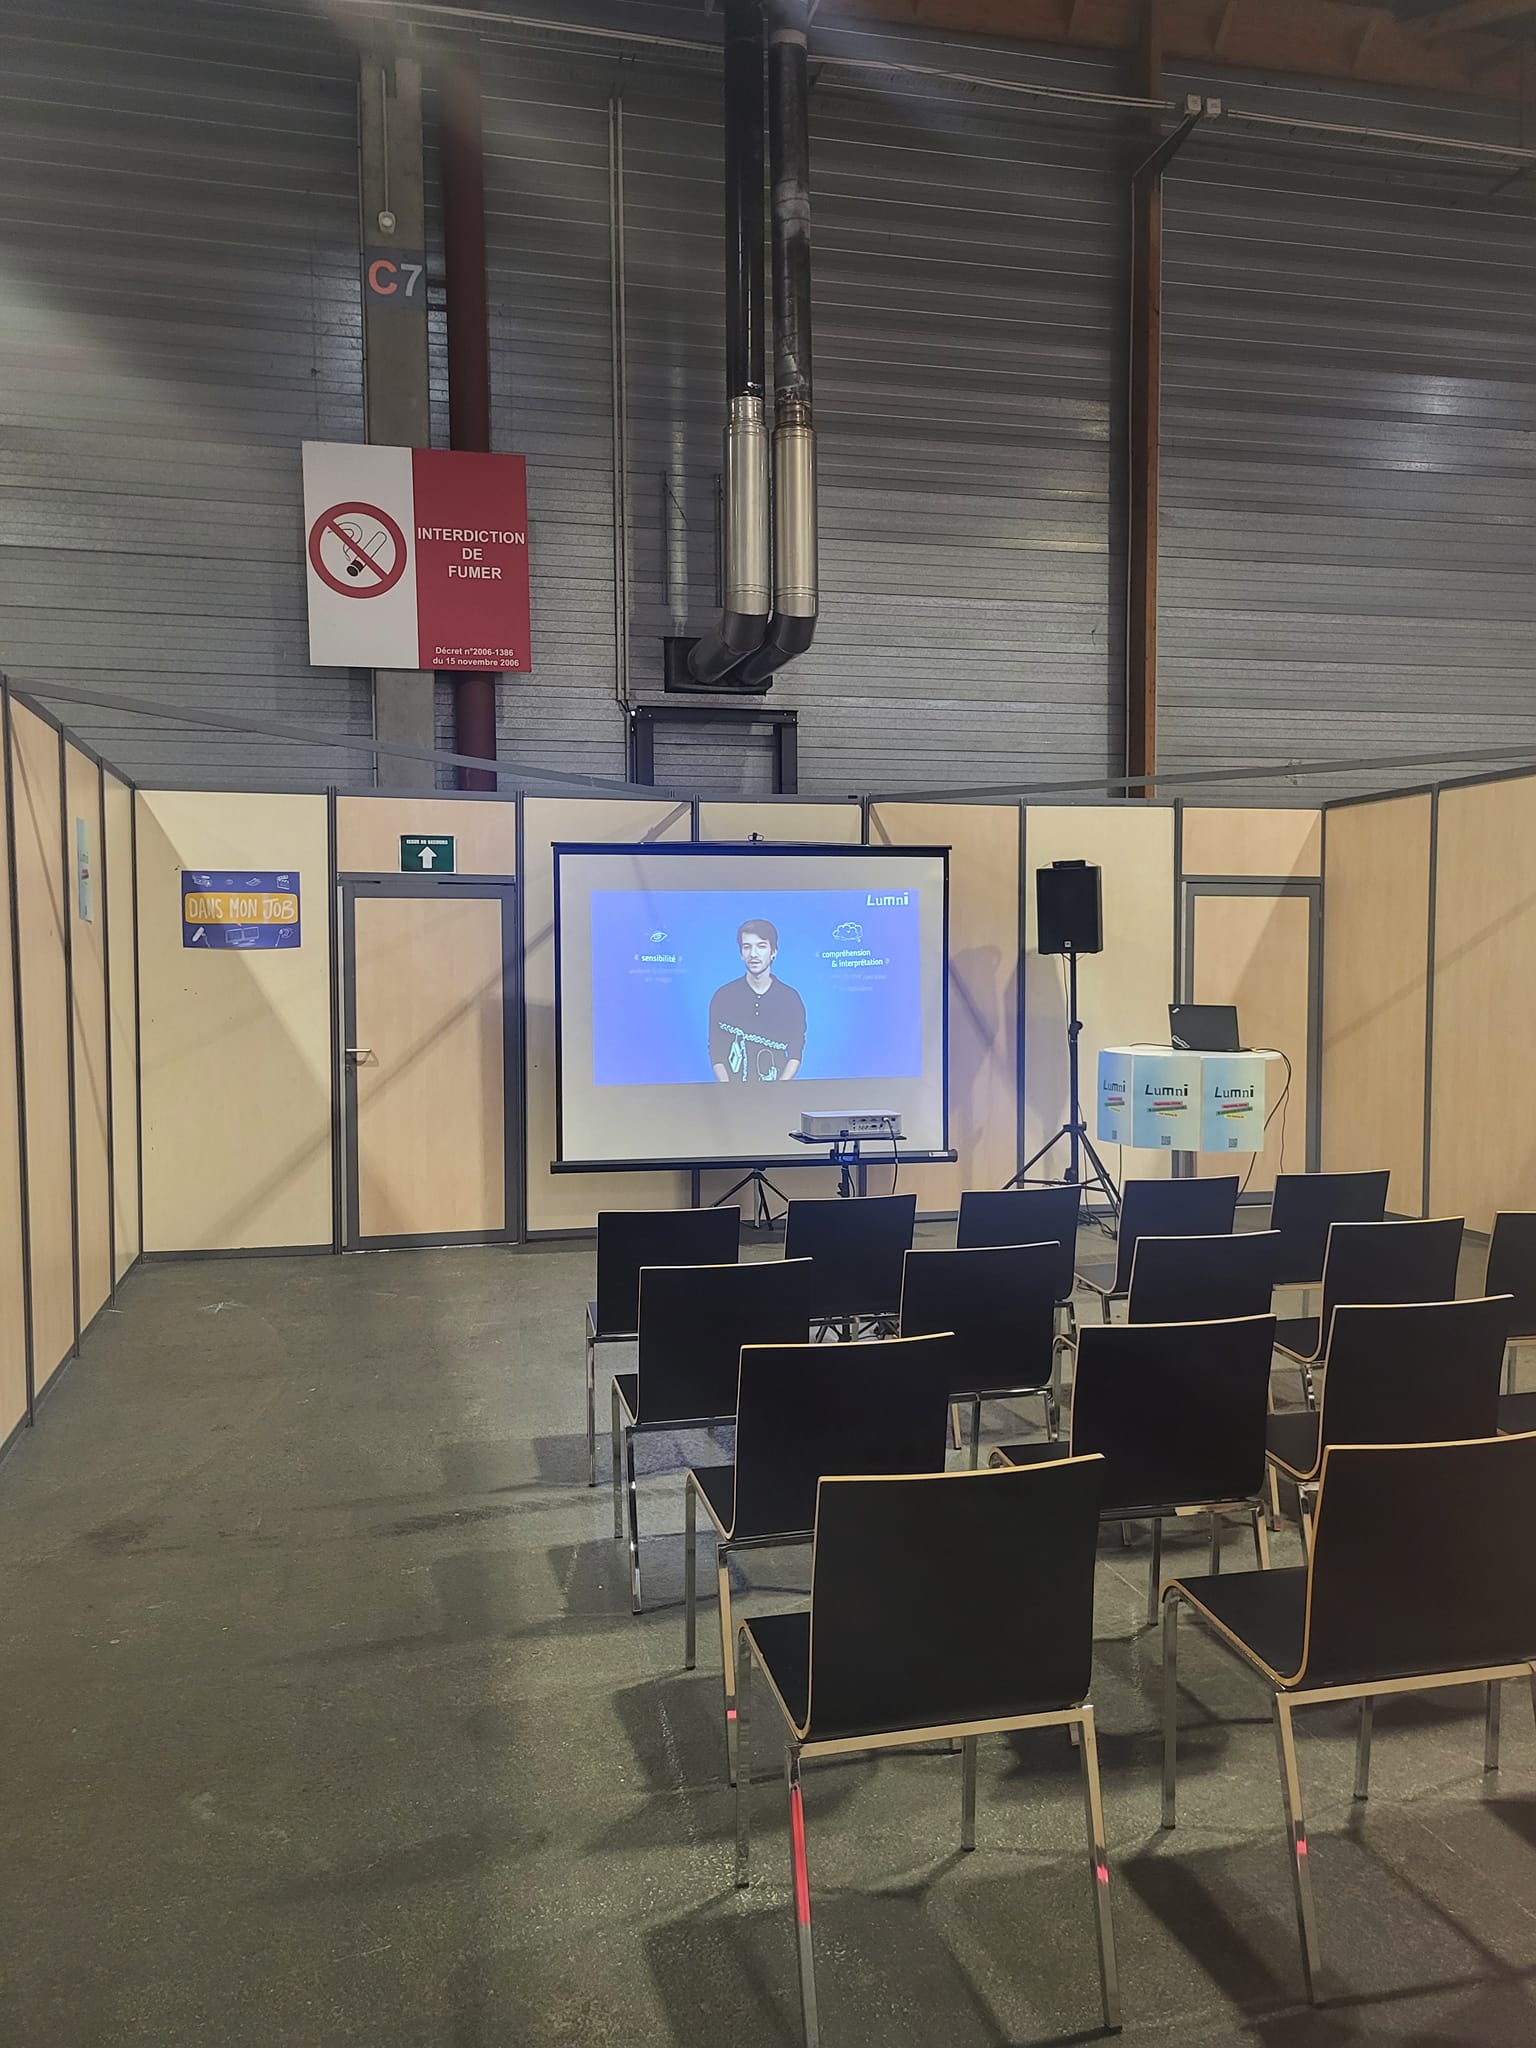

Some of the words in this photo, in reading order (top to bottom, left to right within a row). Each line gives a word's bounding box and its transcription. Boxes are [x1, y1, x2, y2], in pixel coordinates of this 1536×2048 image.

[368, 259, 423, 297] C7
[418, 527, 525, 544] INTERDICTION
[462, 548, 483, 561] DE
[448, 566, 502, 580] FUMER
[435, 647, 462, 655] Décret
[432, 657, 443, 665] du
[457, 658, 498, 666] novembre
[500, 659, 519, 667] 2006
[866, 892, 909, 906] Lumni
[188, 897, 223, 919] DANS
[229, 897, 258, 918] MON
[262, 898, 295, 920] JOB
[641, 954, 676, 963] sensibilité
[822, 949, 871, 959] compréhension
[1103, 1079, 1126, 1093] Lumni
[1145, 1083, 1189, 1097] Lumni
[1214, 1085, 1254, 1098] Lumni
